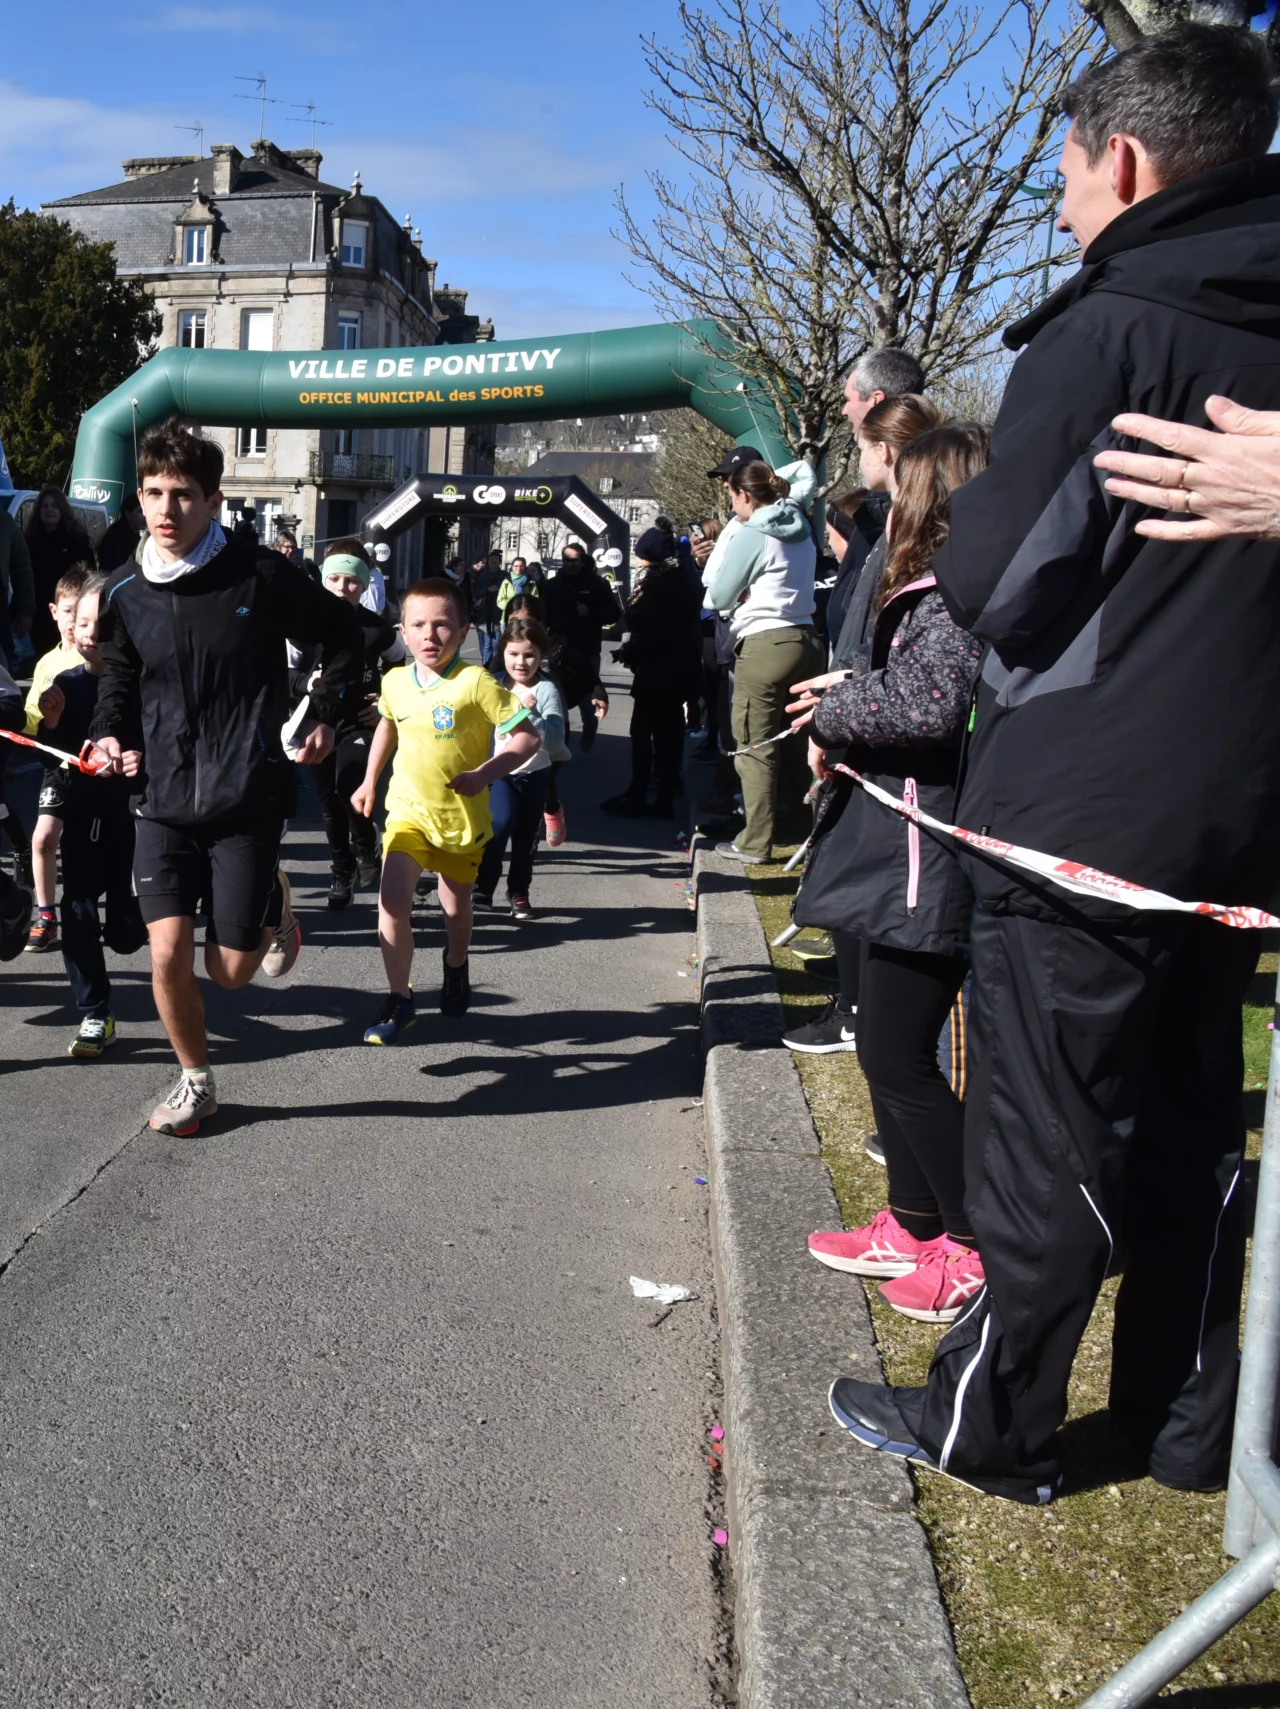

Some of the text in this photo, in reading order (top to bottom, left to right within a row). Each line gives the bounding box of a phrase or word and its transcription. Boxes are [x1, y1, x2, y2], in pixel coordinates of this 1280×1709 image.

[288, 348, 561, 379] VILLE DE PONTIVY
[299, 385, 545, 405] OFFICE MUNICIPAL des SPORTS
[514, 488, 539, 497] BIKE
[381, 494, 417, 525] SUPERSTORE
[569, 497, 605, 529] SUPERSTORE
